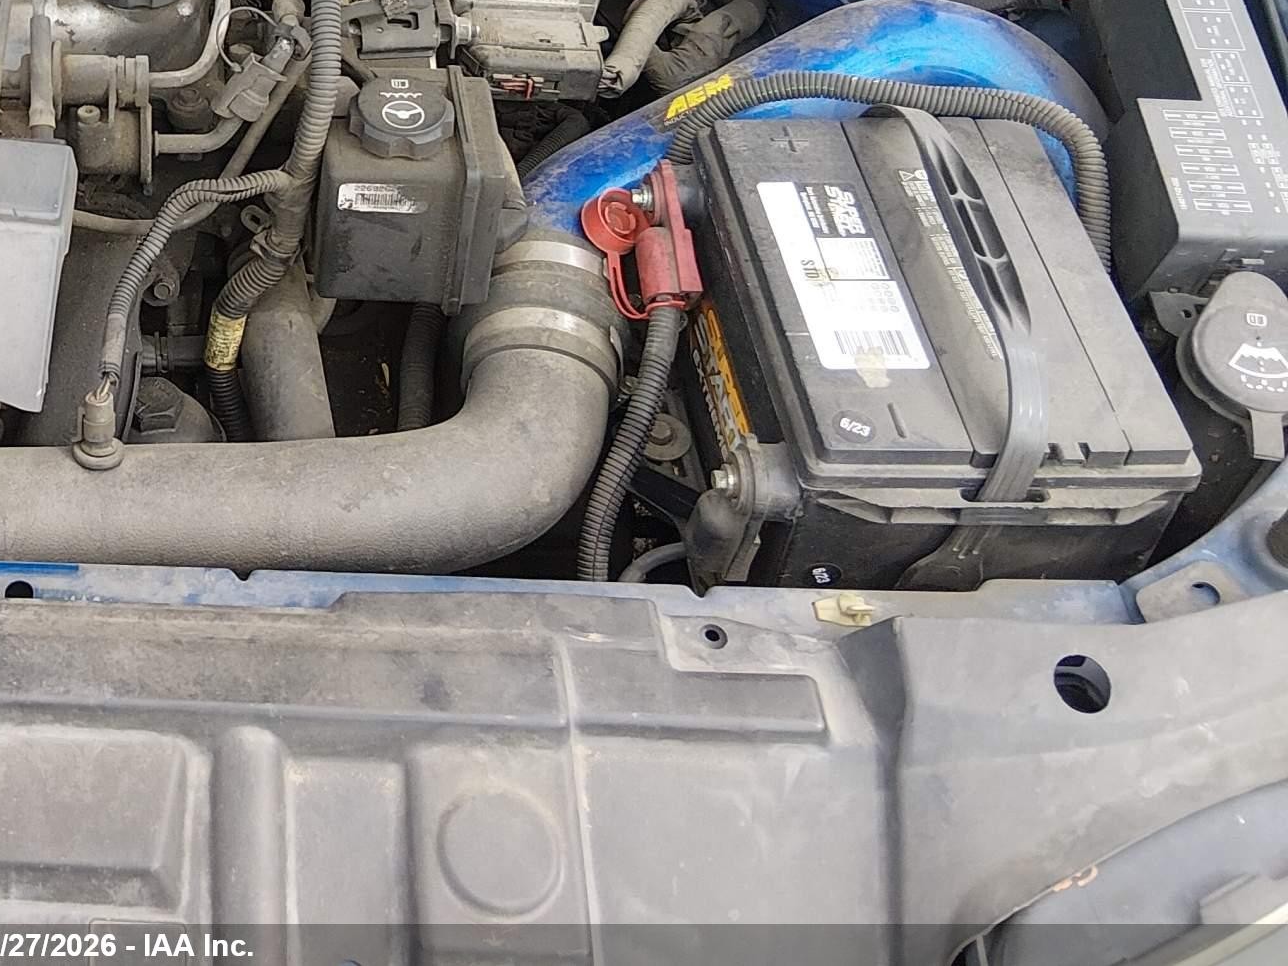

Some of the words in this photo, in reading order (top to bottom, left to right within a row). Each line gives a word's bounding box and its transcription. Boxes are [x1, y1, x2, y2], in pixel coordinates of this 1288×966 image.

[667, 74, 732, 119] AEM
[838, 190, 866, 234] SUPER
[839, 417, 871, 437] 6/23
[812, 567, 831, 584] 6/23
